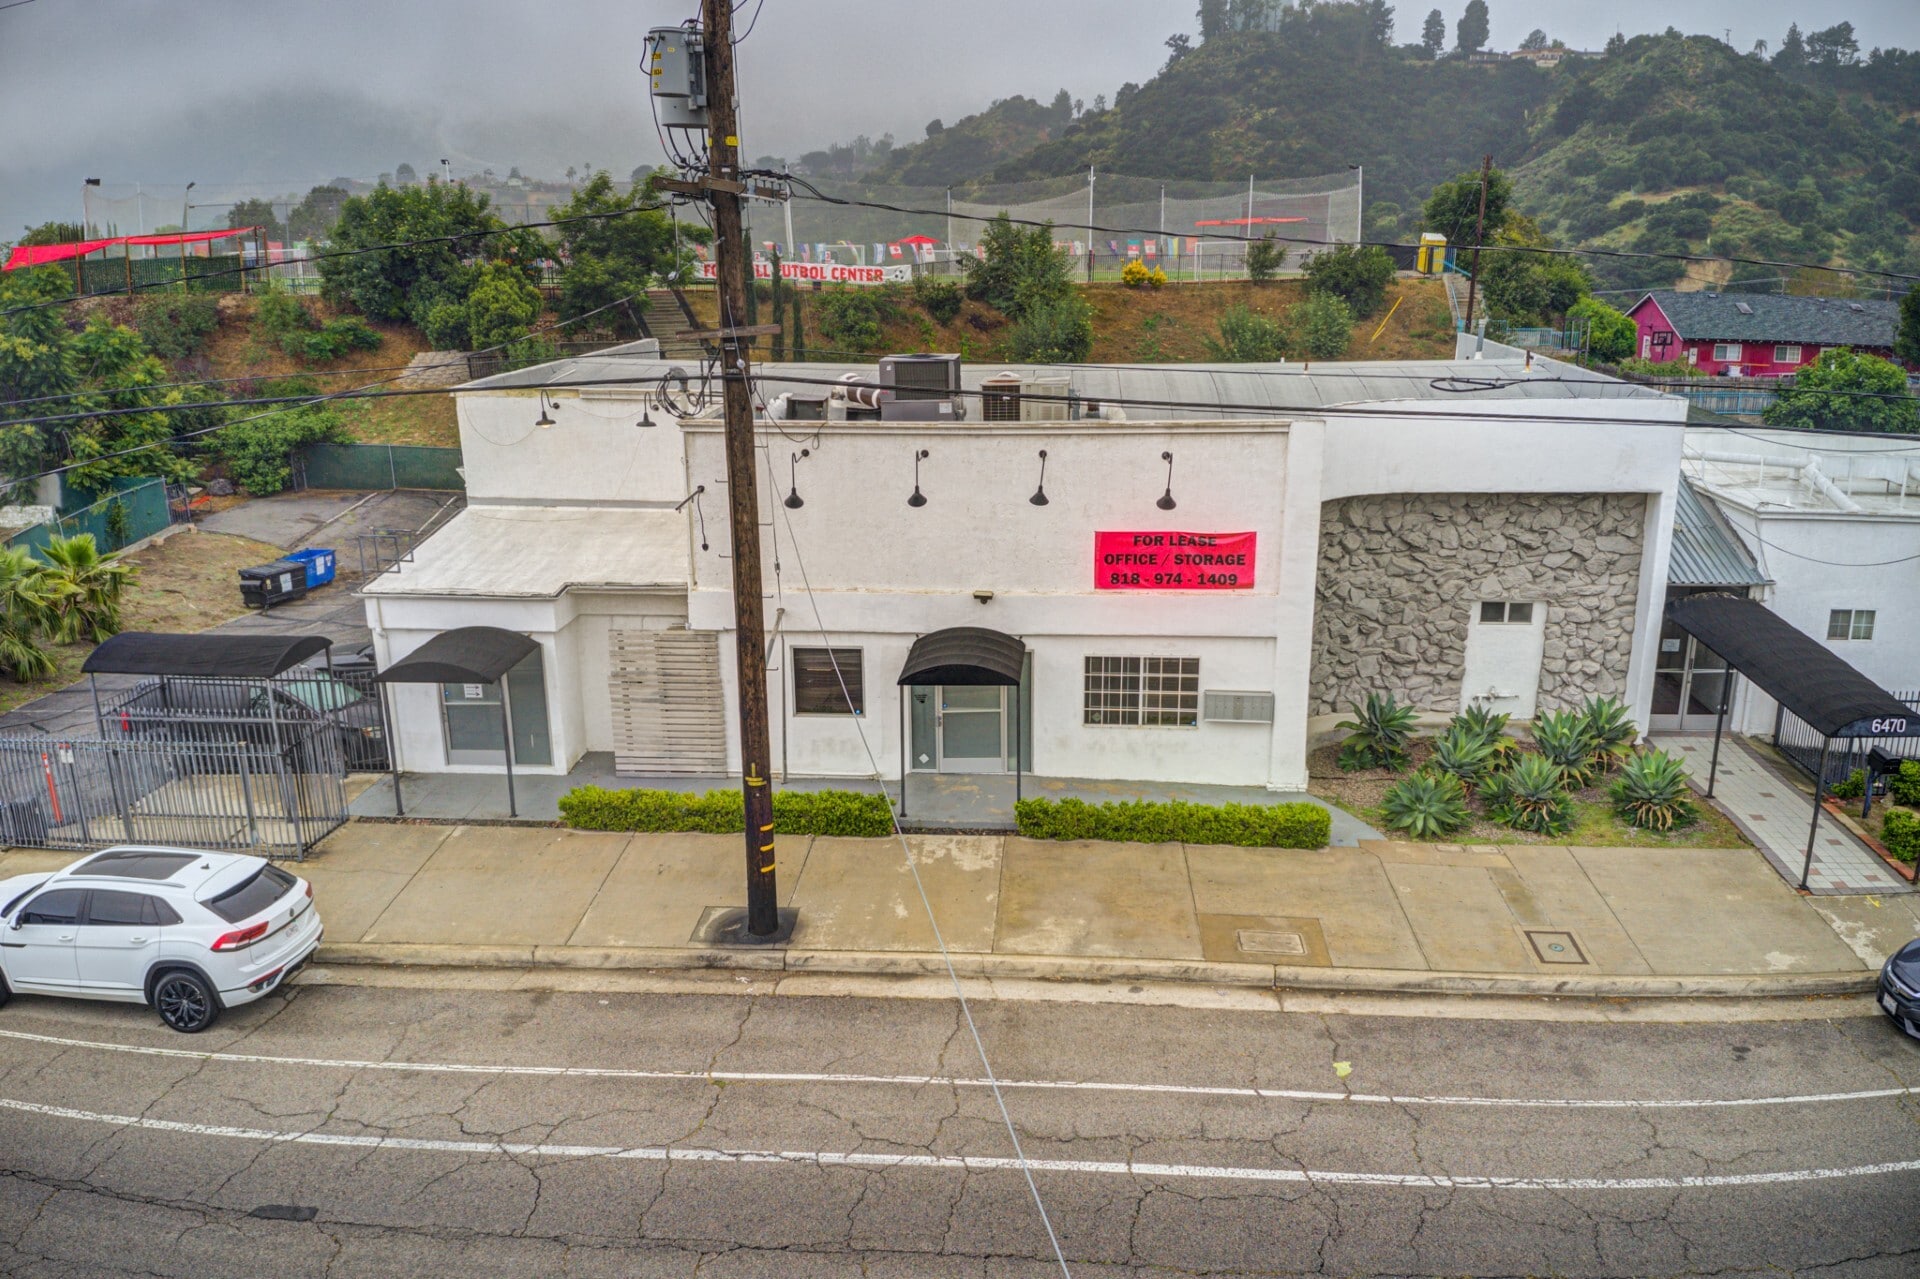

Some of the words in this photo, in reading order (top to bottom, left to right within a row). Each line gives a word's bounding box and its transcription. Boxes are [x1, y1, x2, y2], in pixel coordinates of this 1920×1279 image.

[779, 264, 827, 281] UTBOL
[831, 267, 884, 283] CENTER
[1133, 535, 1164, 547] FOR
[1169, 535, 1217, 547] LEASE
[1104, 553, 1158, 566] OFFICE
[1174, 553, 1246, 566] STORAGE
[1871, 718, 1907, 733] 6470
